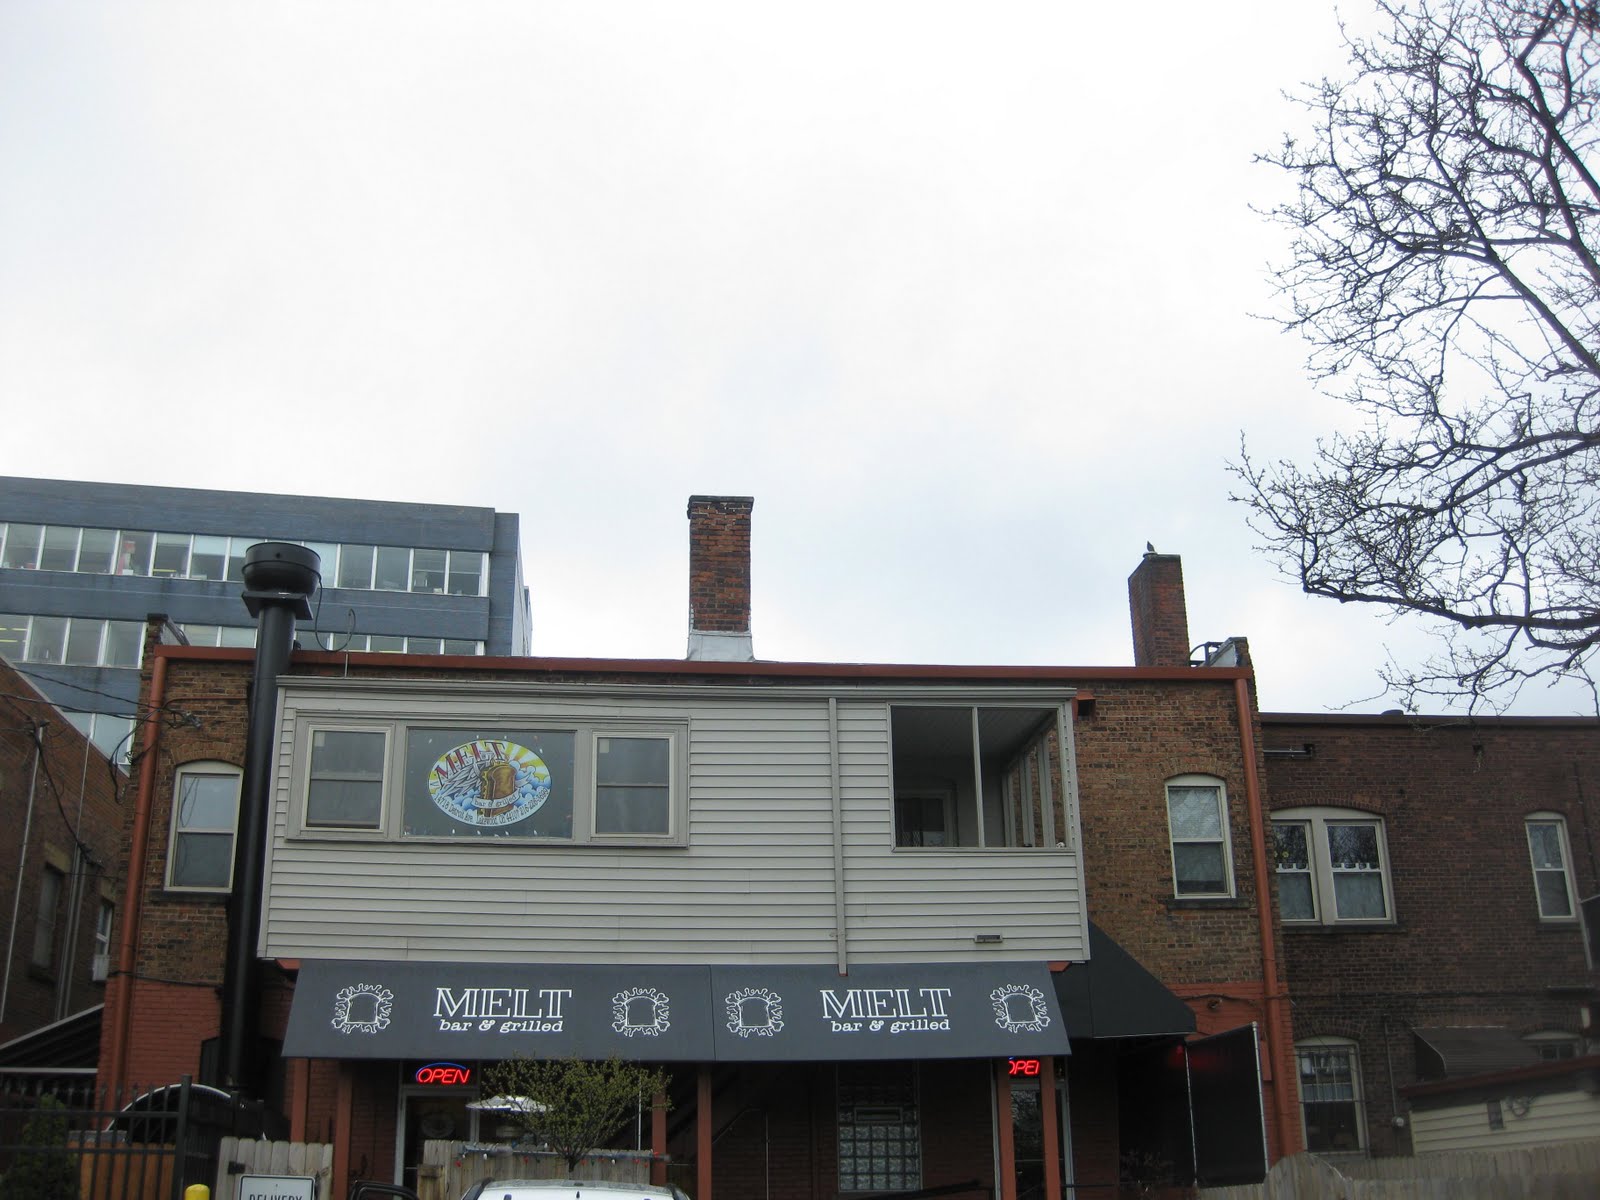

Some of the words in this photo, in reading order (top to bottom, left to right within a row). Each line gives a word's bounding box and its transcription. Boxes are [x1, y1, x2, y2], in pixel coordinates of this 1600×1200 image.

[435, 742, 505, 789] MELT
[433, 987, 573, 1018] MELT
[819, 988, 952, 1019] MELT
[439, 1018, 473, 1032] bar
[478, 1019, 496, 1032] &
[499, 1019, 564, 1034] grilled
[830, 1020, 863, 1033] bar
[868, 1019, 885, 1032] &
[889, 1018, 951, 1034] grilled
[417, 1067, 471, 1085] OPEN
[1008, 1059, 1040, 1075] PE
